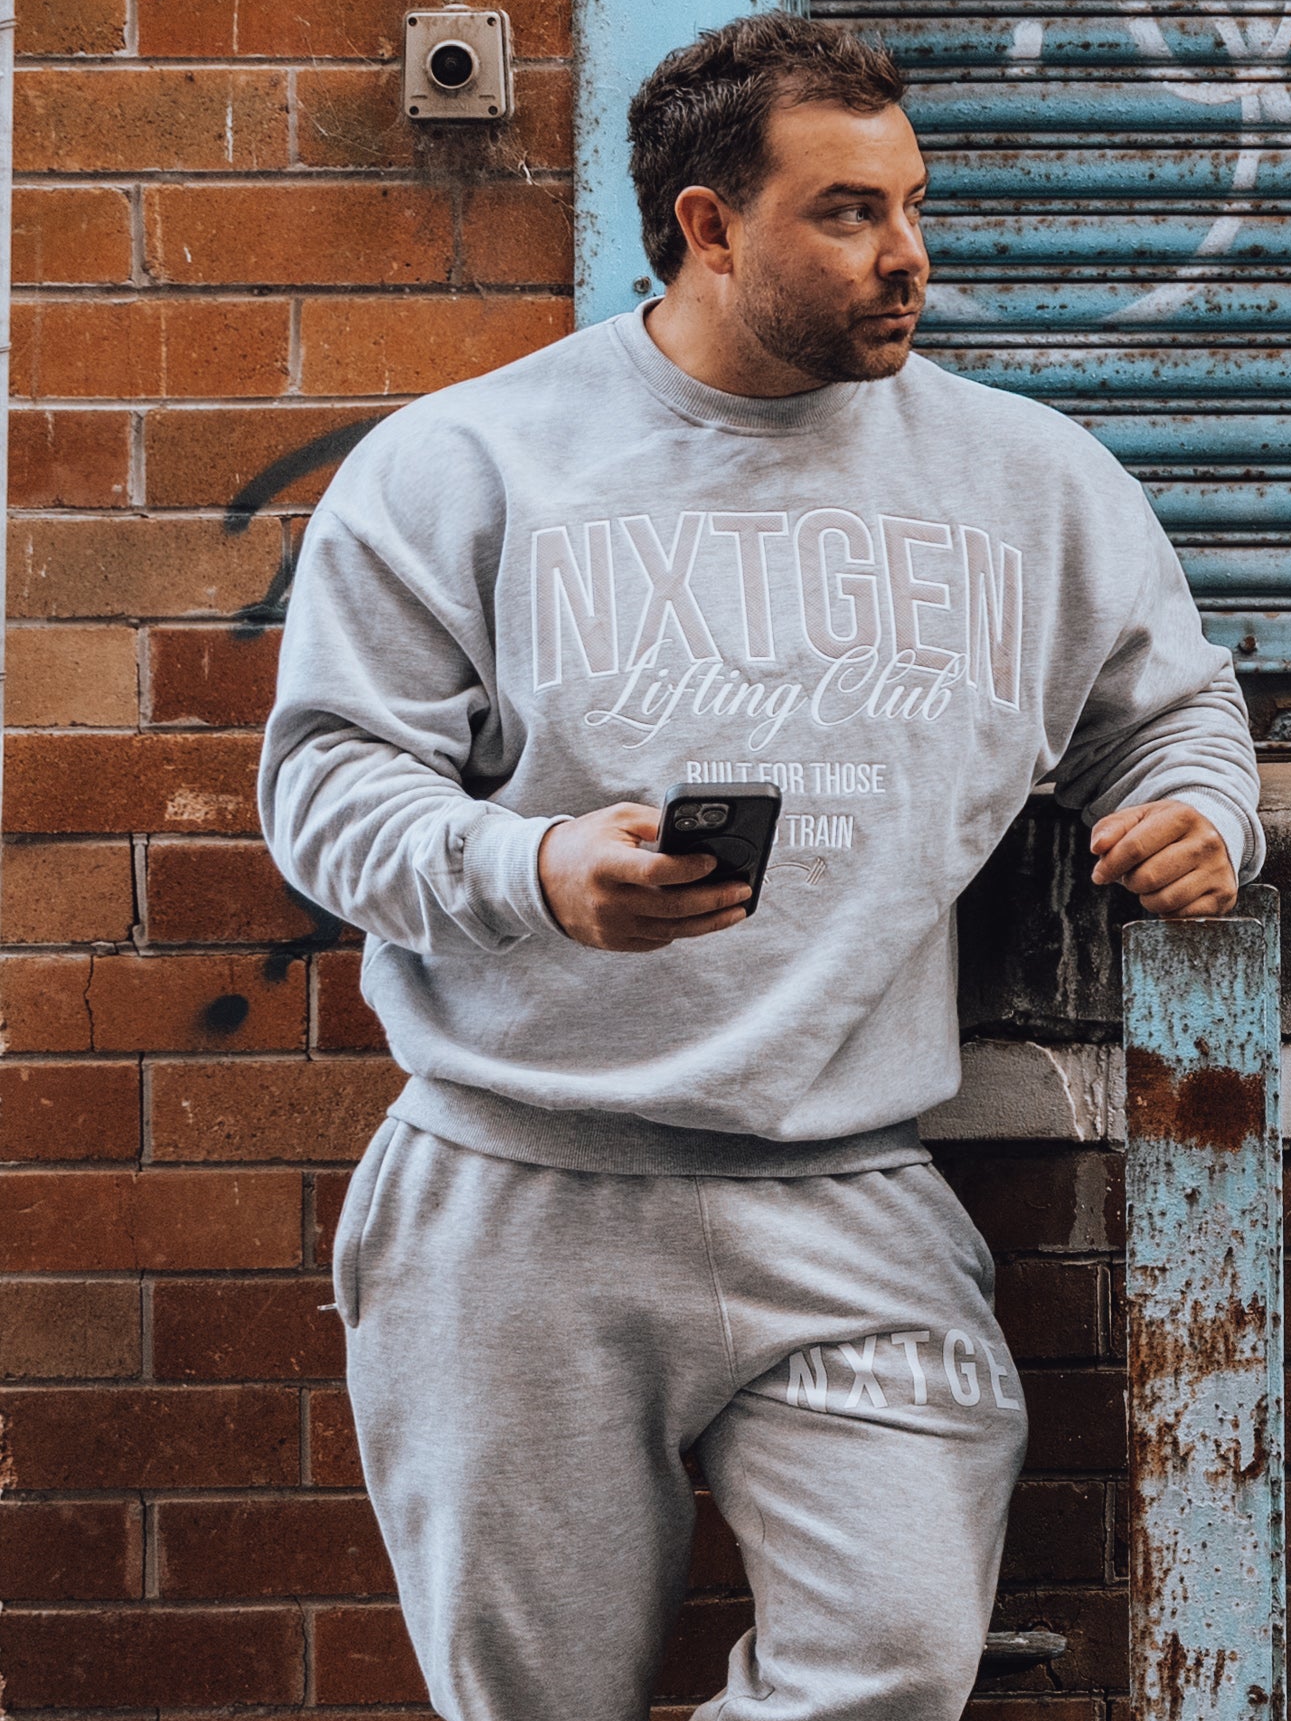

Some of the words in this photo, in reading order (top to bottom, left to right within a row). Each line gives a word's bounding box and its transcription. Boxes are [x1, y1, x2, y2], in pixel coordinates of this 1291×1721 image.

[532, 508, 1022, 711] NXTGEN
[585, 638, 807, 750] Lifting
[809, 645, 967, 726] Club
[759, 762, 804, 794] FOR
[809, 762, 887, 794] THOSE
[785, 815, 854, 848] TRAIN
